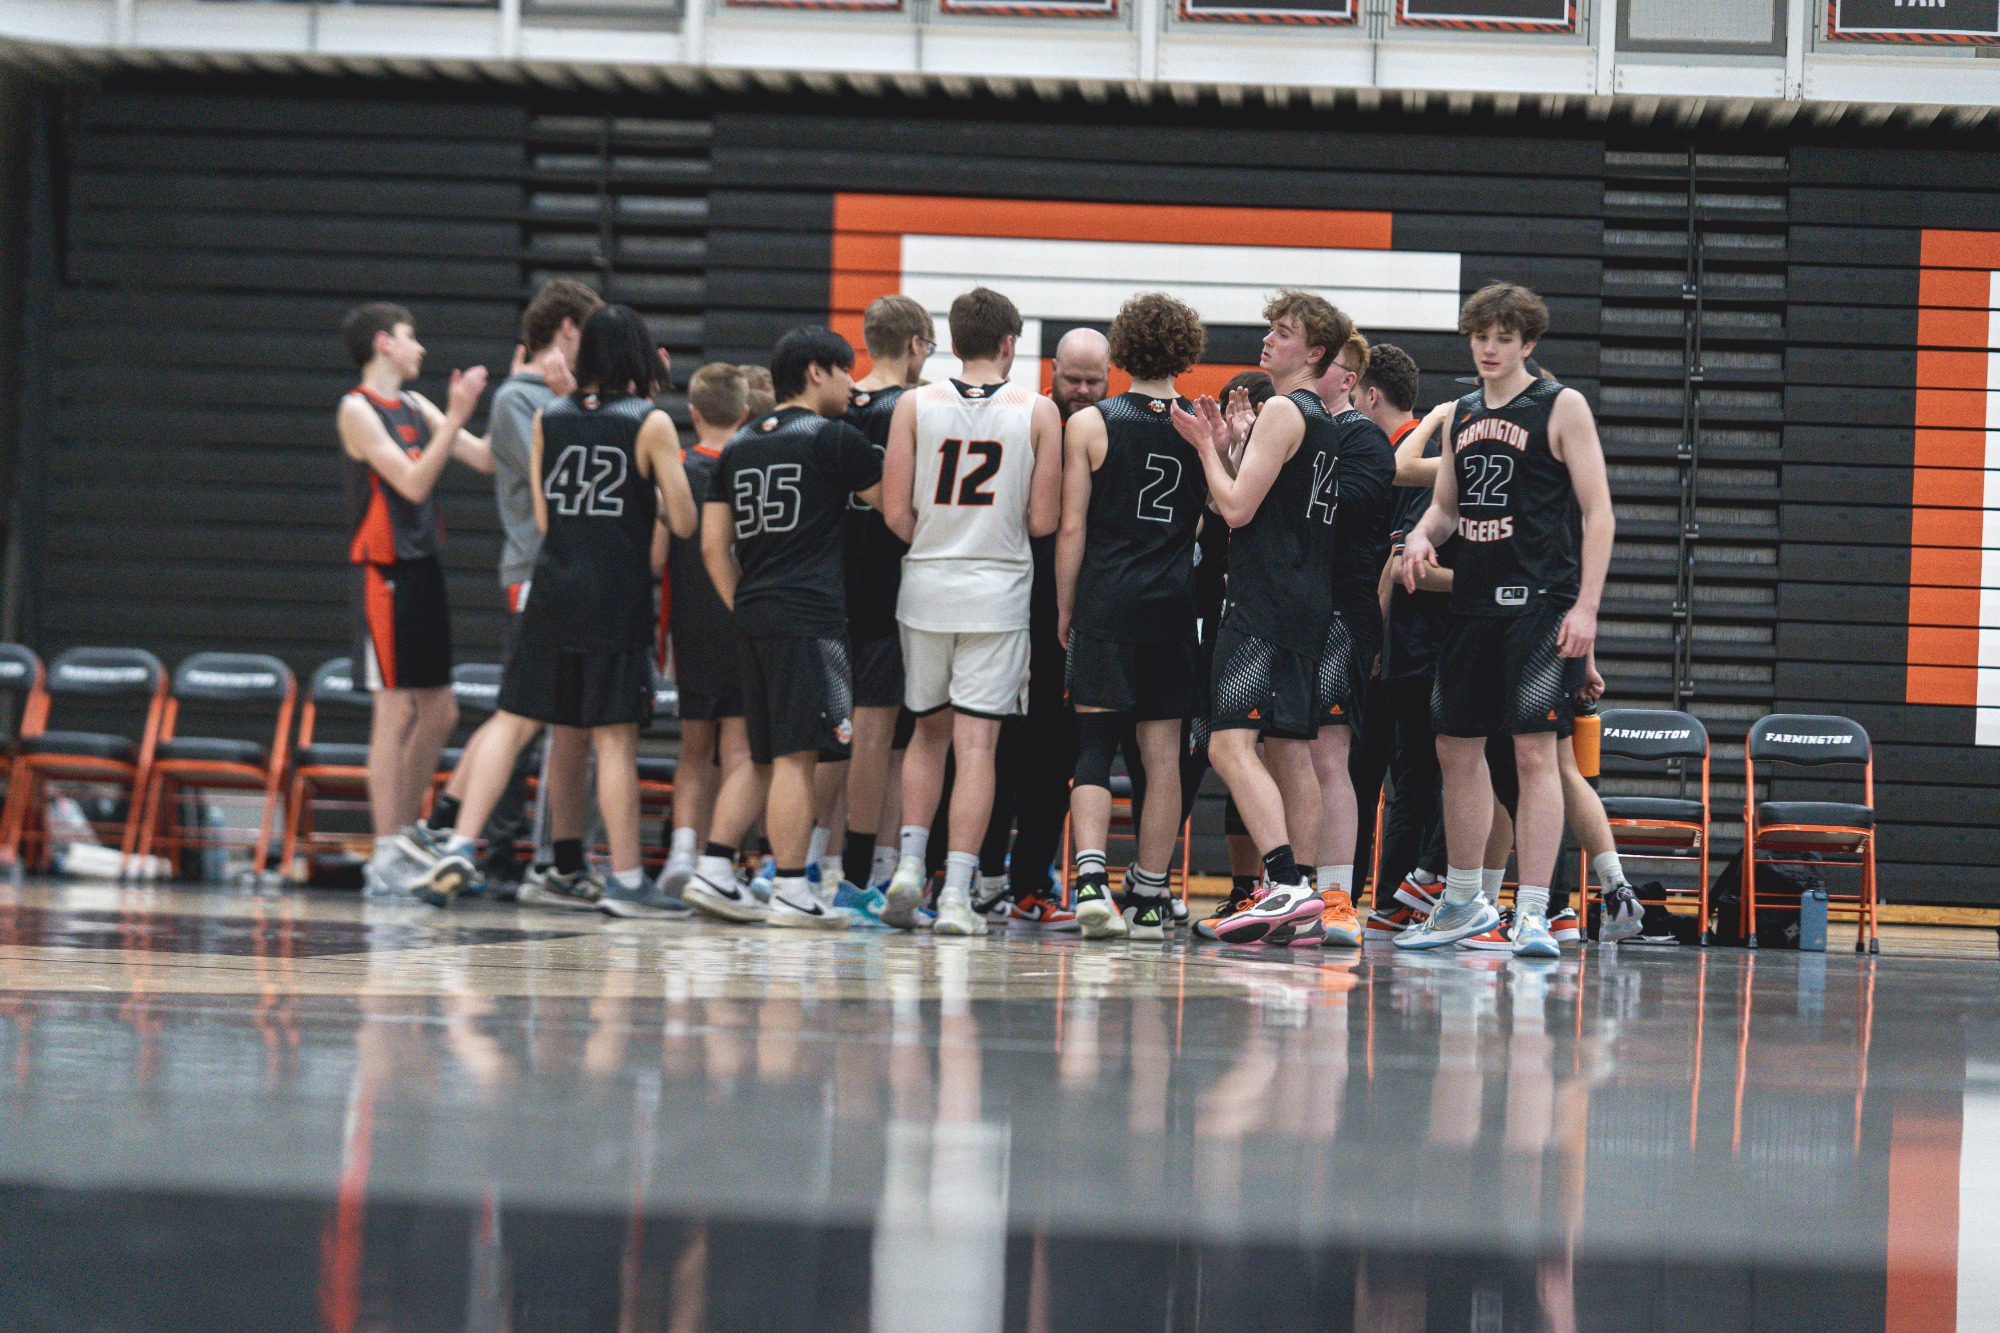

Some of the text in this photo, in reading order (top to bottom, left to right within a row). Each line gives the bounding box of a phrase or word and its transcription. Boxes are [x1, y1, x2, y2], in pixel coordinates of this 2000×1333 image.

[1454, 418, 1530, 456] FARMINGTON
[544, 445, 628, 518] 42
[734, 463, 803, 539] 35
[934, 438, 1004, 506] 12
[1136, 453, 1183, 522] 2
[1306, 451, 1338, 525] 14
[1459, 454, 1515, 507] 22
[1457, 515, 1514, 542] TIGERS
[1603, 727, 1690, 740] FARMINGTON
[1765, 732, 1853, 745] FARMINGTON
